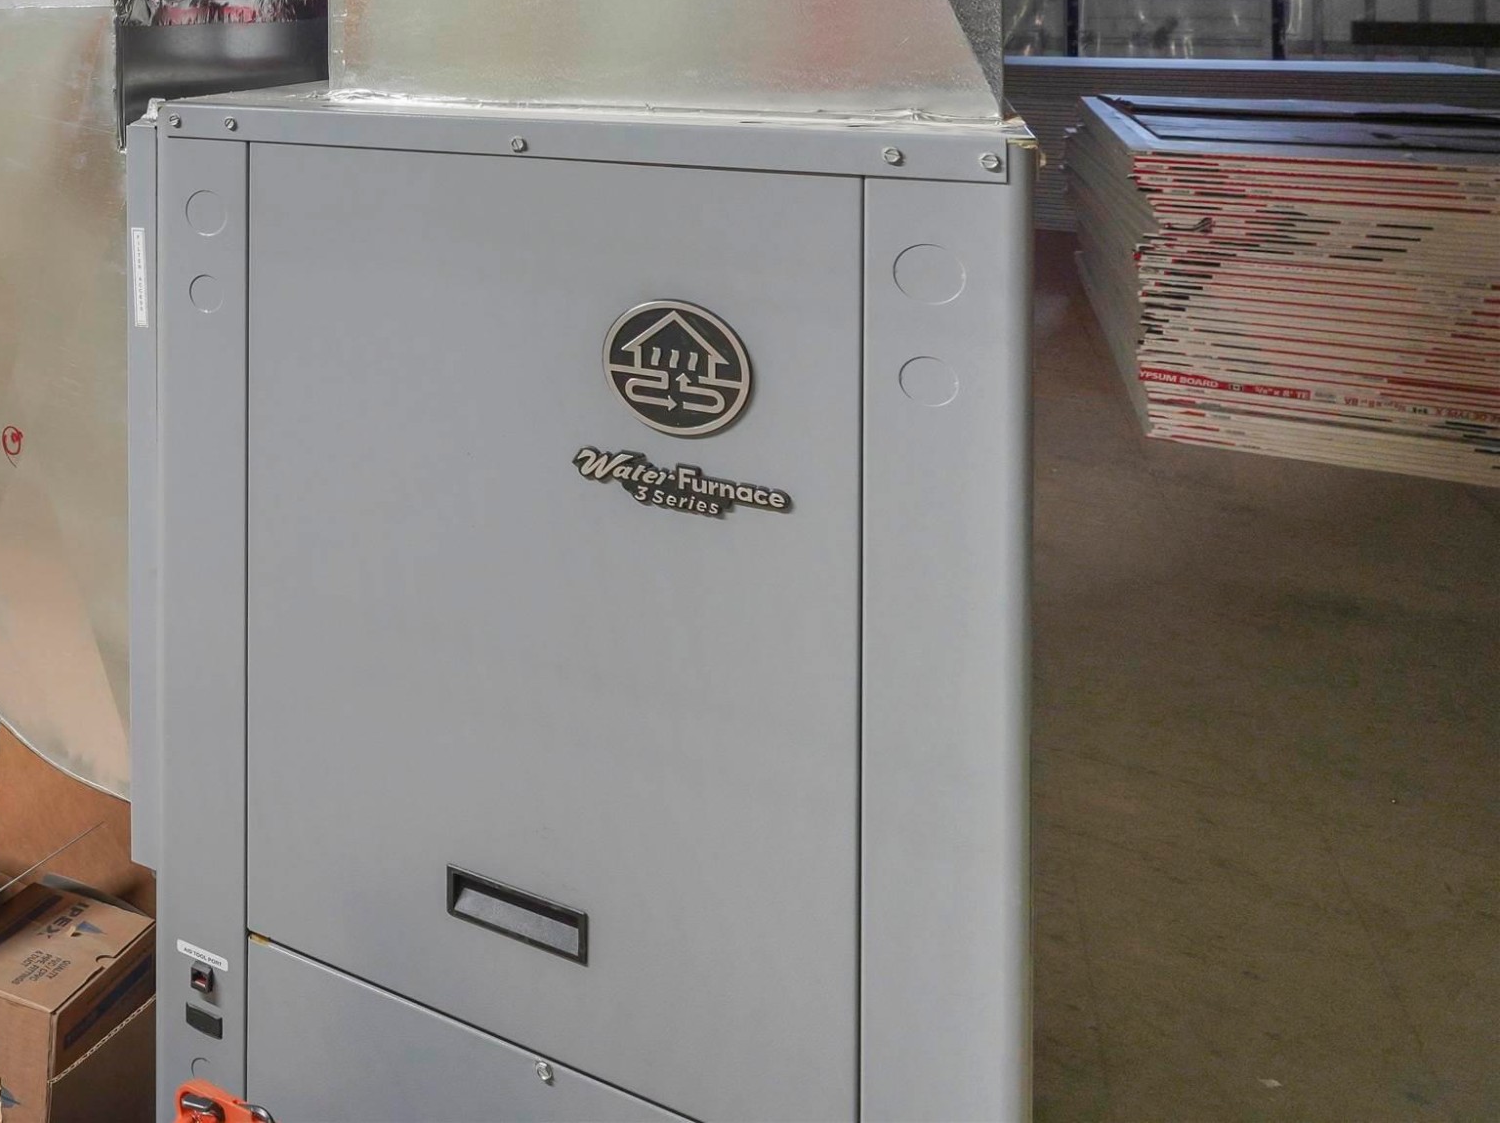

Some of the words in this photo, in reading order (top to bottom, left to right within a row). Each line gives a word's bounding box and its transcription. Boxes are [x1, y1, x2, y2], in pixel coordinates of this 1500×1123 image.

[1179, 376, 1219, 389] BOARD
[634, 485, 647, 502] 3
[652, 489, 720, 516] Series
[37, 903, 90, 936] IPEX
[194, 951, 207, 961] TOOL
[208, 957, 222, 966] PORT
